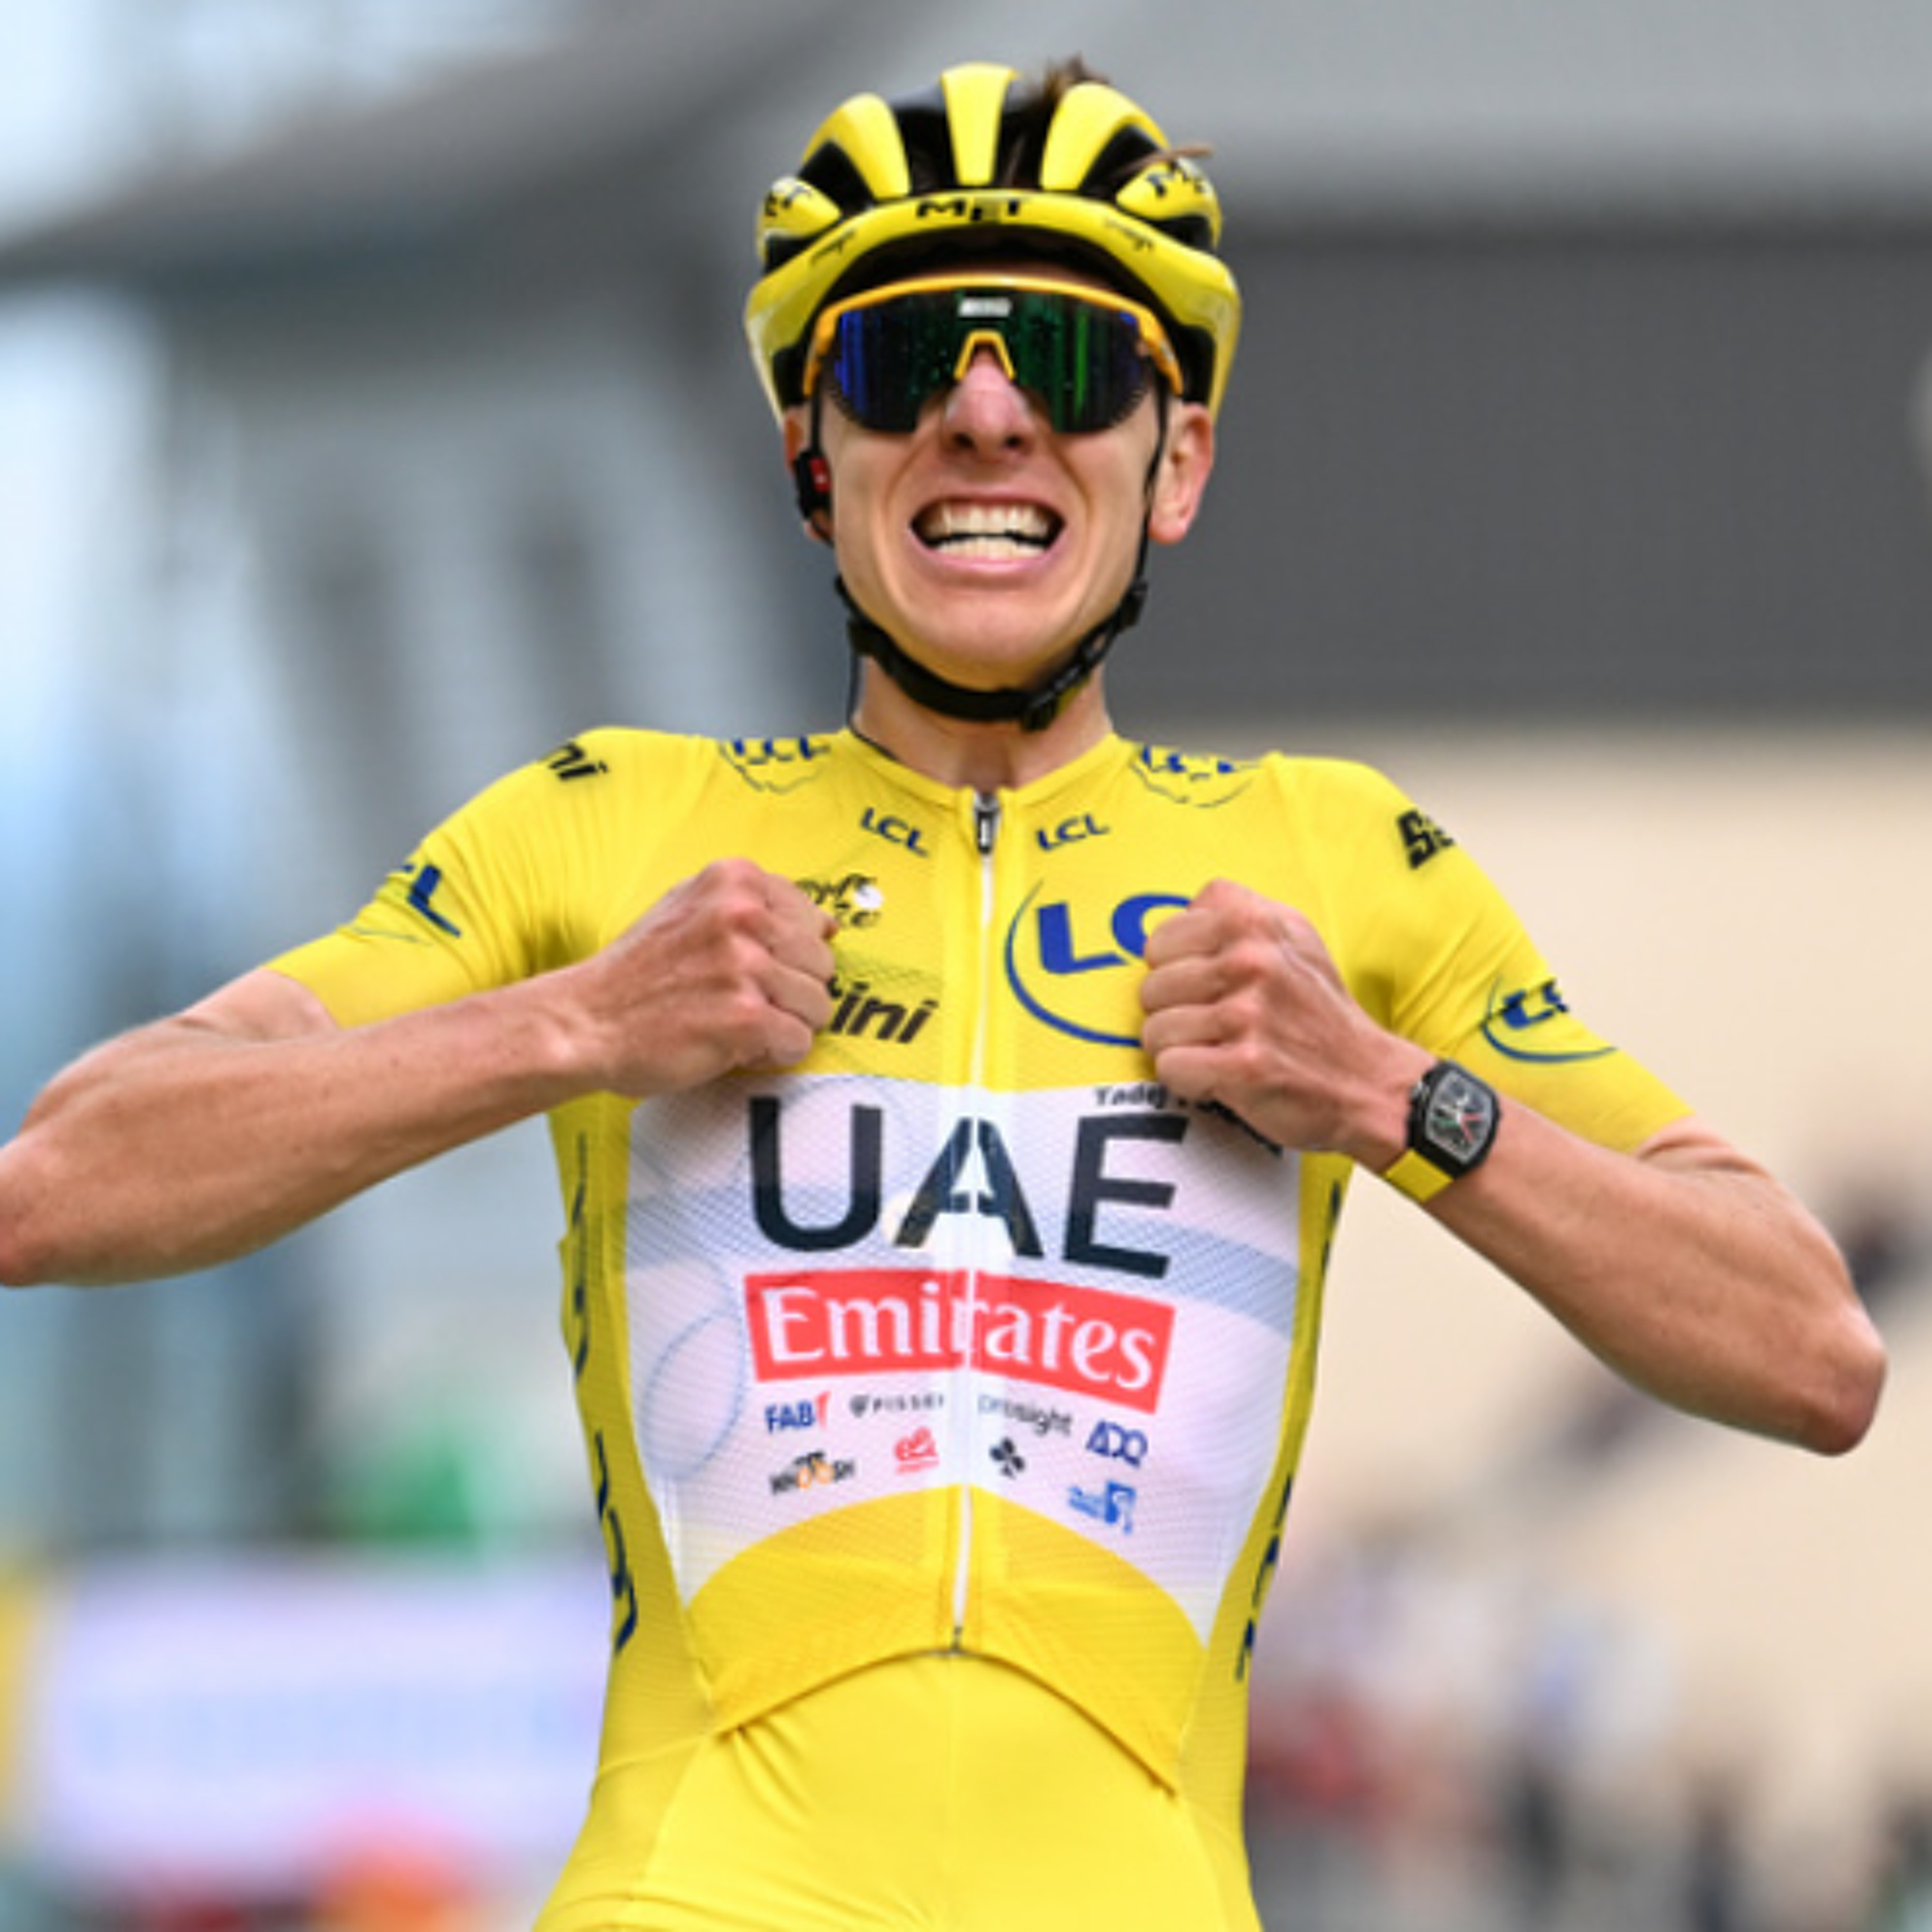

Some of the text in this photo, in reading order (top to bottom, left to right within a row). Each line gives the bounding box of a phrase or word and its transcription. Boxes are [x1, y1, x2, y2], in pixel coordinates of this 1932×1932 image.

[860, 807, 929, 858] LCL
[1036, 813, 1110, 851] LCL
[1037, 894, 1193, 974] LC
[748, 1097, 1189, 1279] UAE
[760, 1282, 1157, 1391] Emirates
[765, 1400, 814, 1434] FAB
